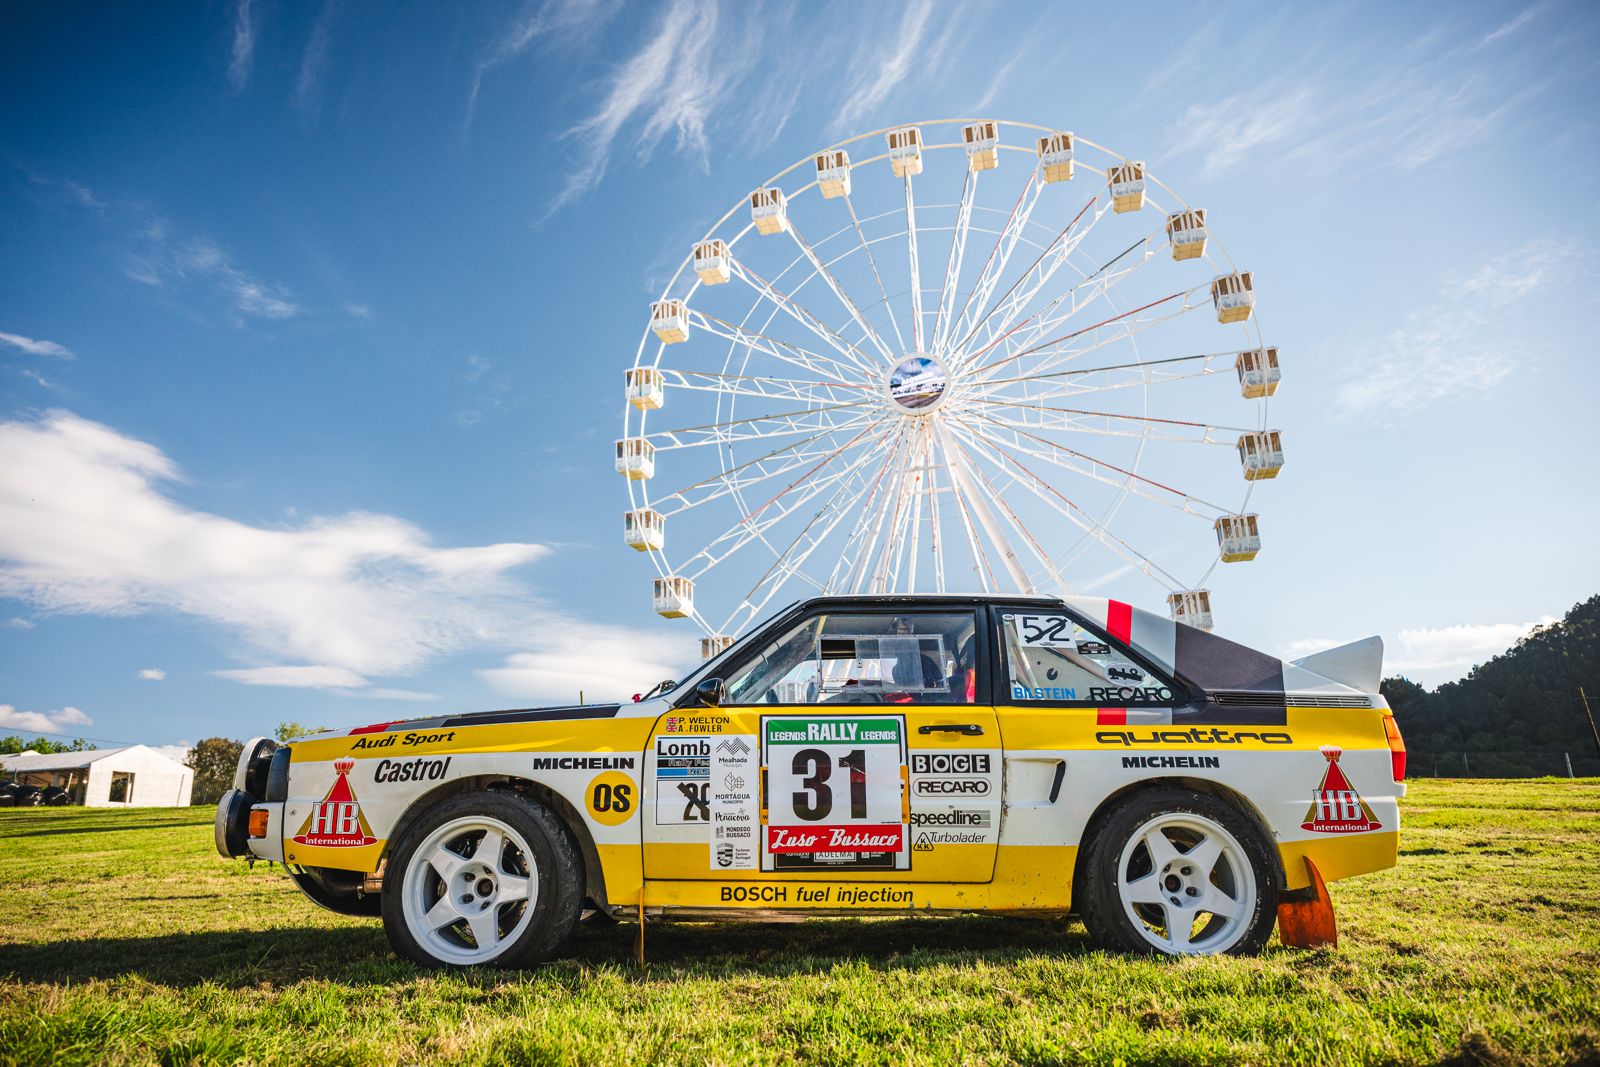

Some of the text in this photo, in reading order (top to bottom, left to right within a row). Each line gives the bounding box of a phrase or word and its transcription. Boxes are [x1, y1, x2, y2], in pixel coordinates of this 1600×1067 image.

[1013, 687, 1076, 699] BILSTEIN
[1089, 686, 1175, 701] RECARO
[350, 731, 456, 750] Audi Sport
[770, 723, 897, 741] LEGENDS RALLY LEGENDS
[1095, 728, 1293, 747] quattro
[657, 740, 710, 756] Lomb
[374, 756, 452, 784] Castrol
[533, 757, 635, 770] MICHELIN
[914, 755, 987, 772] BOGE
[1121, 756, 1220, 769] MICHELIN
[792, 748, 867, 821] 31
[918, 781, 989, 793] RECARO
[593, 783, 631, 813] OS
[1312, 789, 1362, 821] HB
[310, 801, 360, 835] HB
[910, 809, 982, 828] speedline
[1313, 823, 1371, 831] international
[305, 836, 365, 846] international
[770, 829, 818, 849] Luso
[828, 828, 900, 847] Bussaco
[930, 832, 987, 843] Turbolader
[720, 886, 914, 905] BOSCH fuel injection
